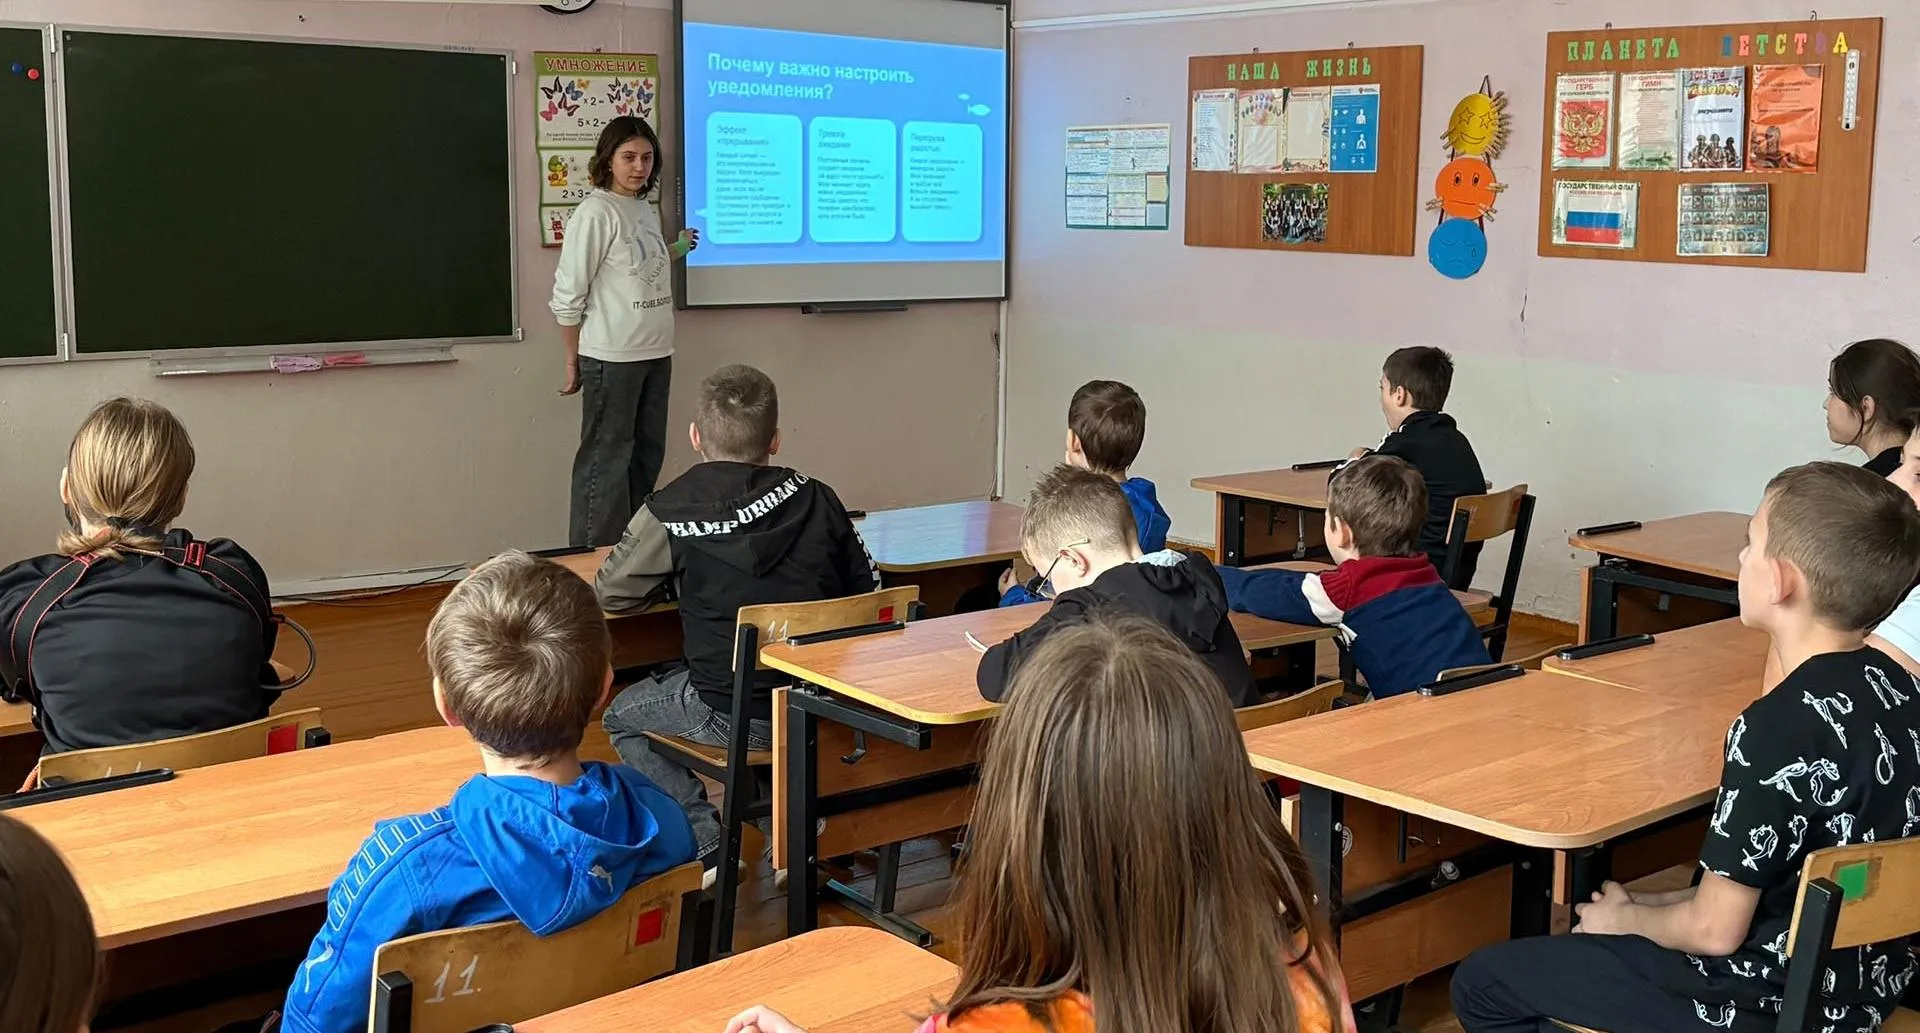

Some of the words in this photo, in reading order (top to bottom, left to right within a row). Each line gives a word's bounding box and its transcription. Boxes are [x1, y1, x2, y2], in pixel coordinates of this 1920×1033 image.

[1567, 37, 1680, 62] ПЛАНЕТА
[545, 58, 649, 73] УМНОЖЕНИЕ
[707, 52, 774, 78] Почему
[779, 62, 830, 78] важно
[835, 66, 915, 84] настроить
[1227, 62, 1280, 81] НАША
[1306, 57, 1372, 78] ЖИЗНЬ
[707, 79, 834, 99] уведомления?
[1575, 83, 1594, 91] ГЕРБ
[767, 619, 789, 642] 11
